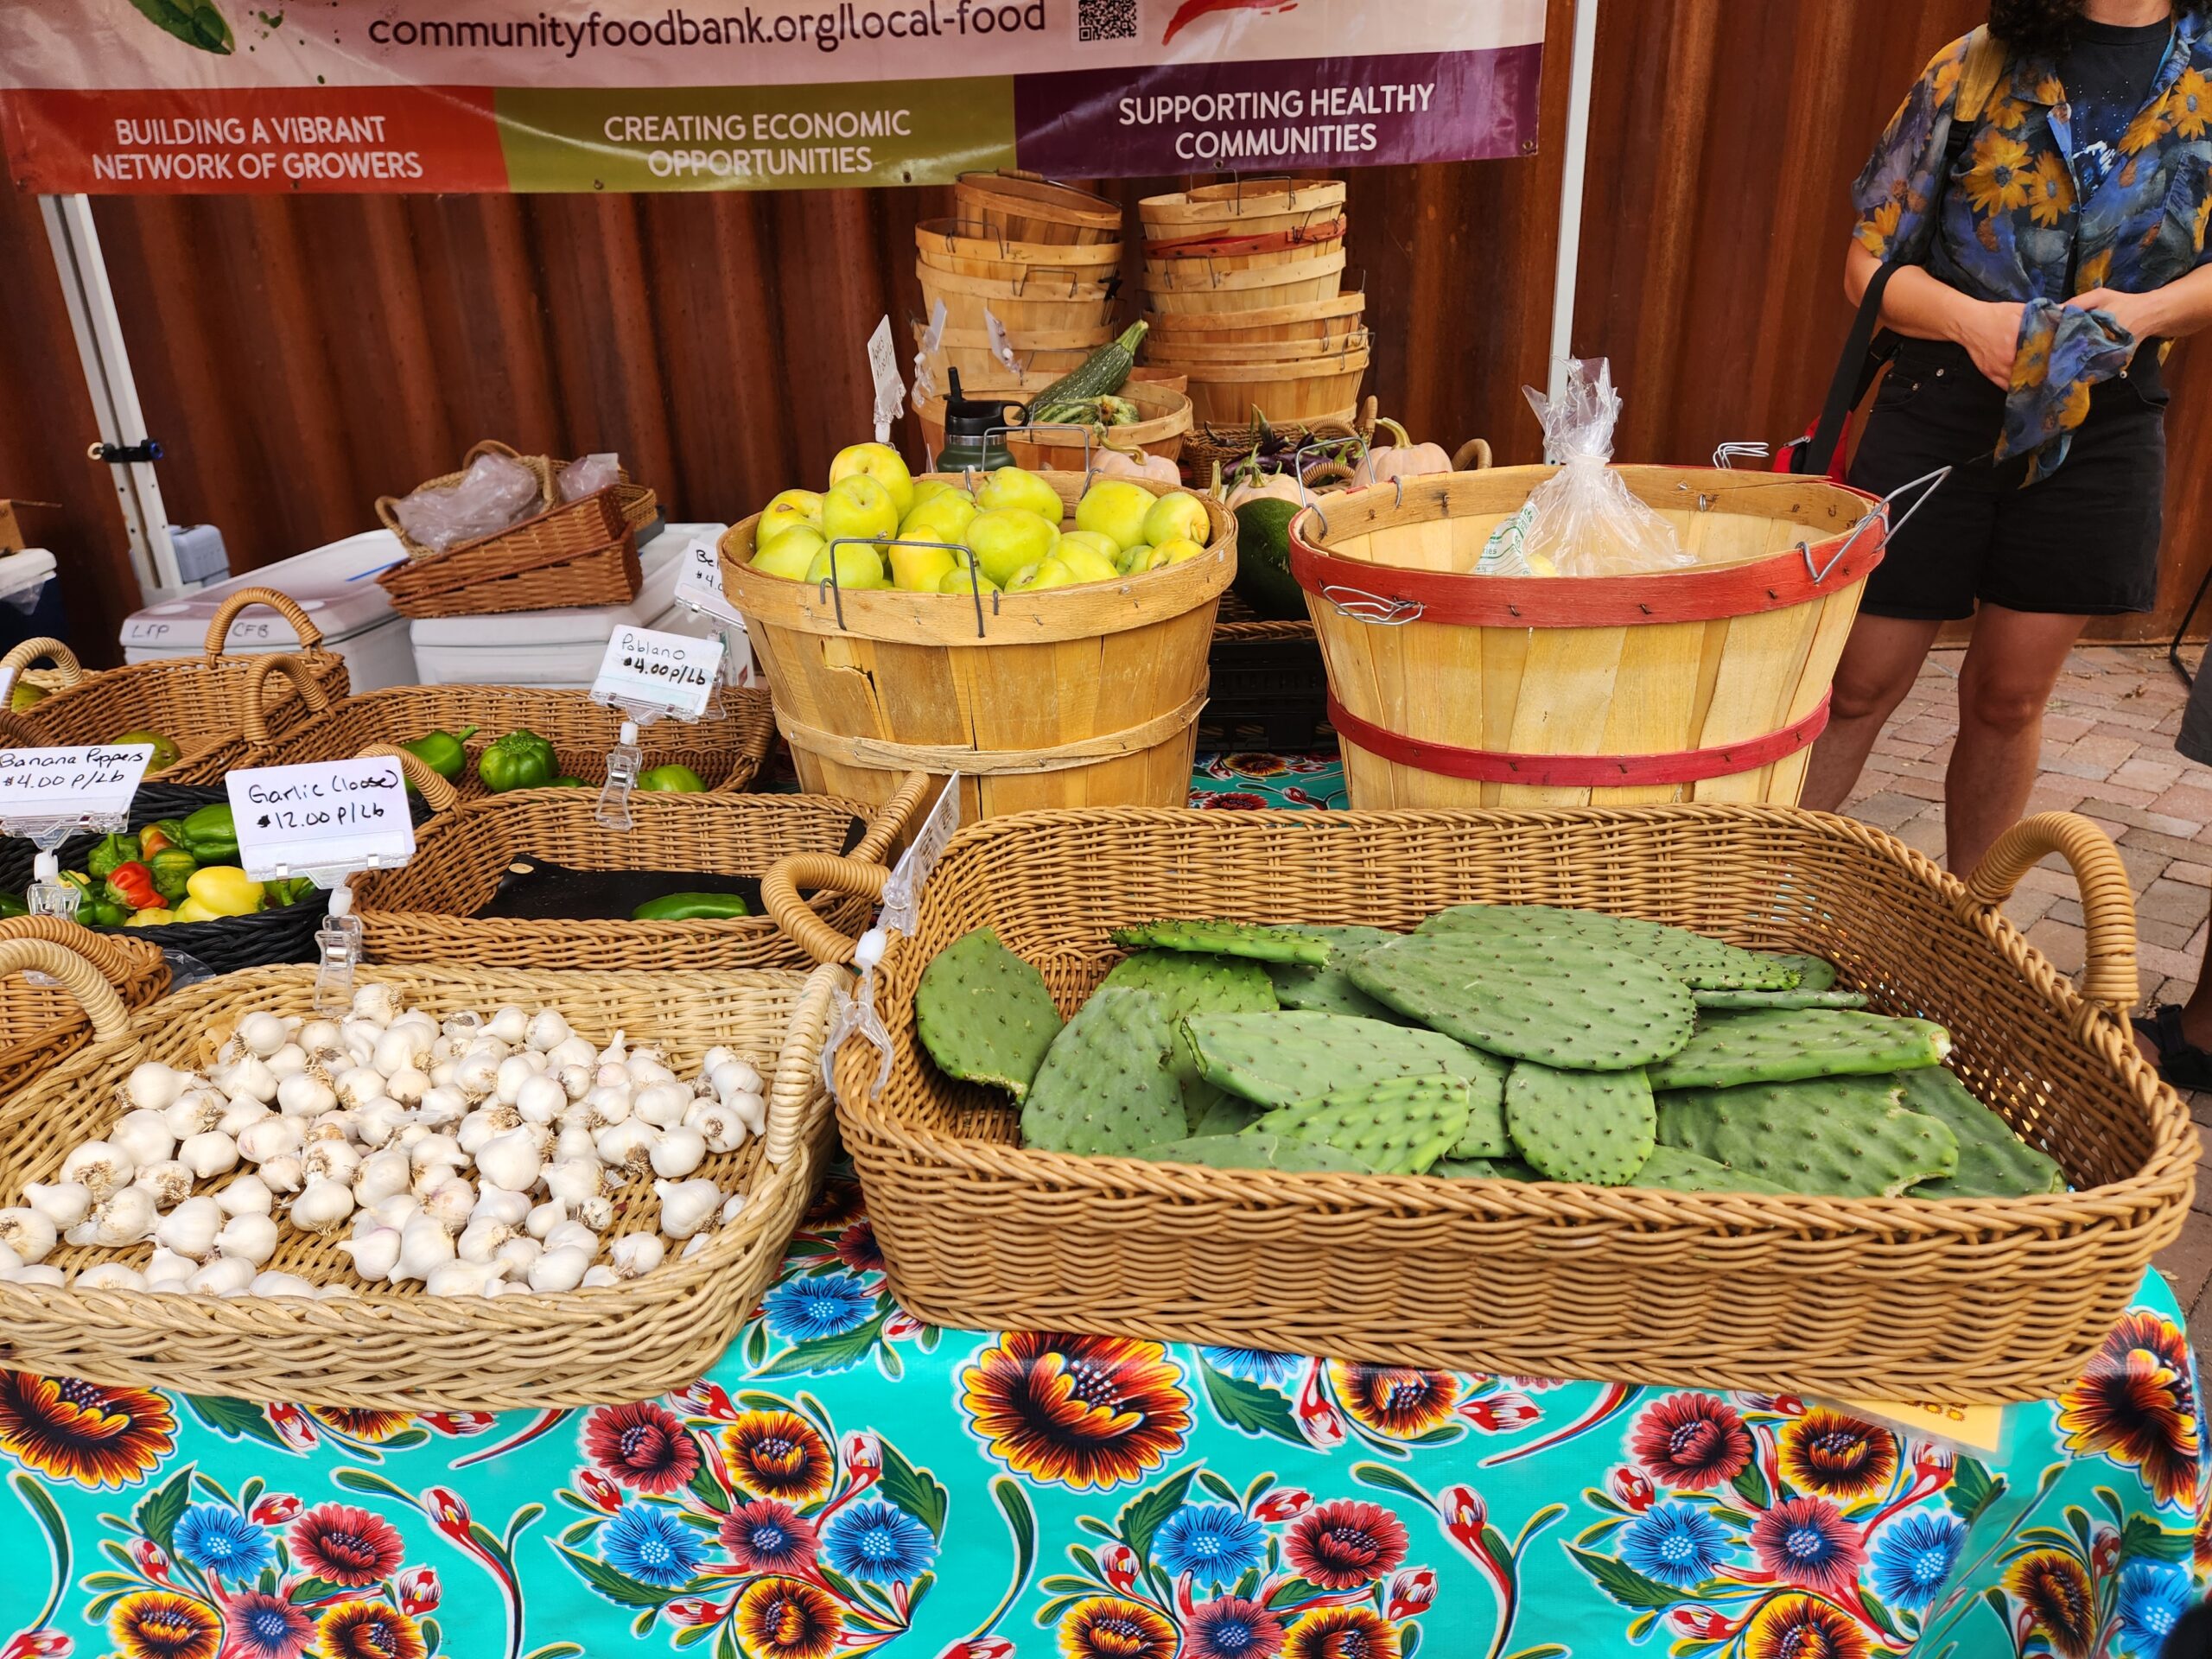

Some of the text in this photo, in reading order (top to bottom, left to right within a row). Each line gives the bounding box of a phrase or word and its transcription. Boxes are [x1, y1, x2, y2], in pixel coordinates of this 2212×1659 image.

[368, 0, 1046, 58] communityfoodbank.org/local-food
[1119, 83, 1435, 125] SUPPORTING HEALTHY
[115, 116, 385, 145] BUILDING A VIBRANT
[604, 110, 911, 142] CREATING ECONOMIC
[1175, 124, 1376, 160] COMMUNITIES
[92, 152, 423, 181] NETWORK OF GROWERS
[649, 147, 873, 177] OPPORTUNITIES
[621, 632, 686, 660] Poblano
[0, 753, 77, 768] Banana
[3, 773, 65, 789] $4.00
[249, 784, 324, 804] Garlic
